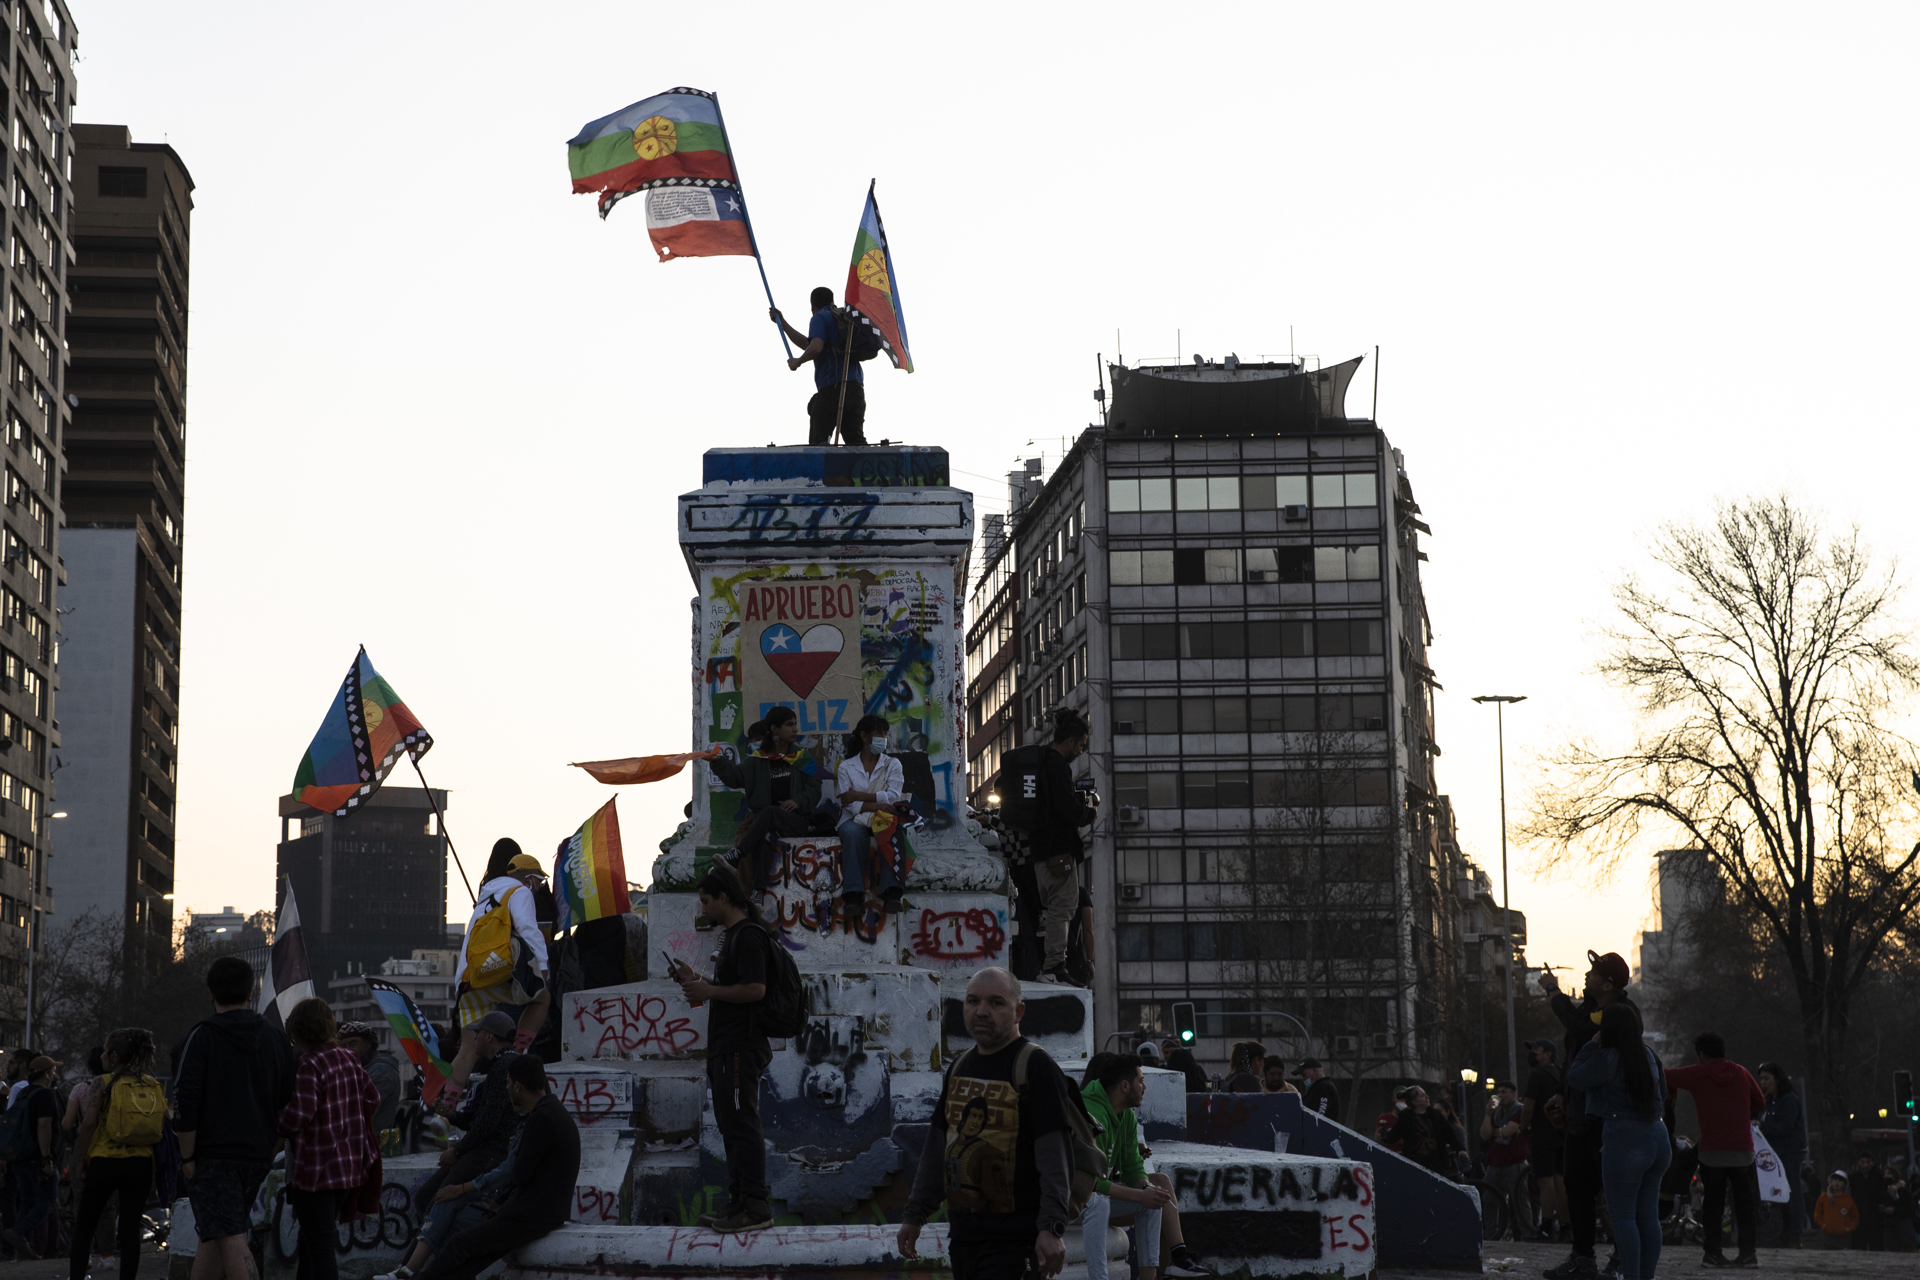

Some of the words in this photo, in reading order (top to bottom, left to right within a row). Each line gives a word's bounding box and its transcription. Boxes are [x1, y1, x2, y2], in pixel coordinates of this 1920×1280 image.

[885, 569, 911, 578] FALSA
[745, 583, 854, 622] APRUEBO
[759, 699, 849, 732] FLIZ
[564, 832, 597, 899] APRUEBO
[480, 960, 508, 973] adidas
[594, 1018, 700, 1058] ACAB
